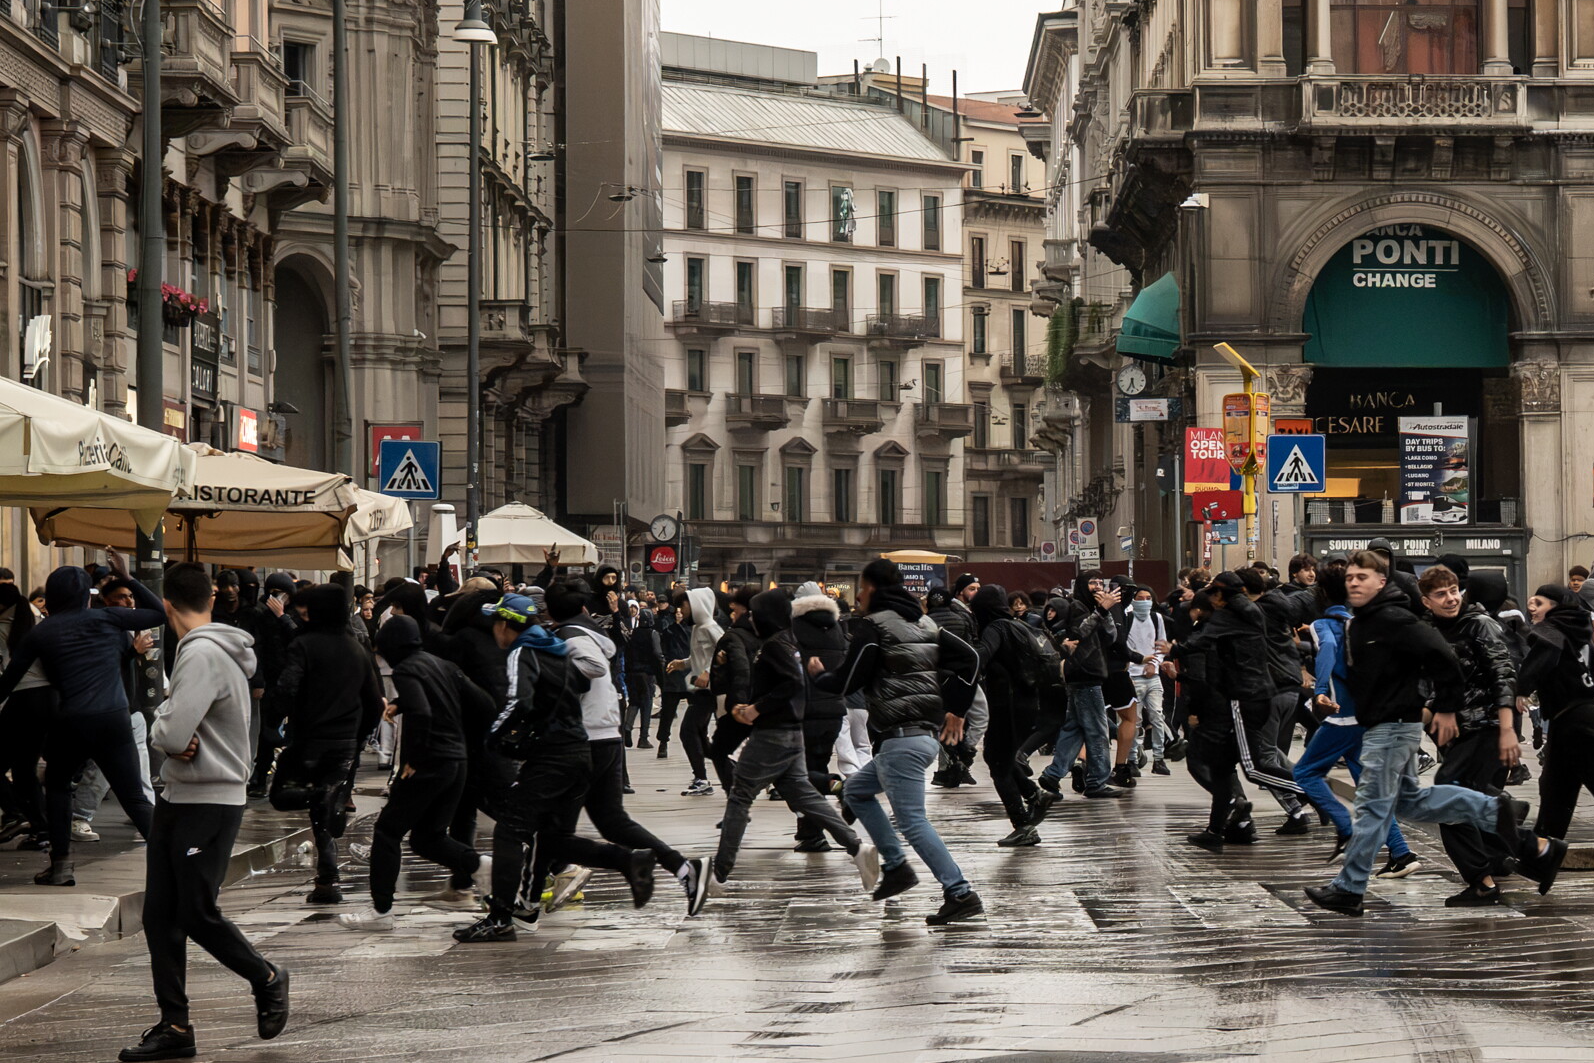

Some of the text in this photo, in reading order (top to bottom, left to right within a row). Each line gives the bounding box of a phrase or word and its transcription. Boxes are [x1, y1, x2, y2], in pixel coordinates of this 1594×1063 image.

[1366, 224, 1423, 236] ANCA
[1352, 239, 1460, 265] PONTI
[1352, 272, 1437, 288] CHANGE
[1315, 416, 1384, 434] CESARE
[1411, 423, 1464, 431] Autostradale
[1190, 431, 1224, 440] MILAN
[1190, 440, 1225, 450] OPEN
[1190, 450, 1225, 460] TOUR
[179, 484, 315, 505] ISTORANTE
[1329, 539, 1500, 550] SOUVENI POINT MILANO
